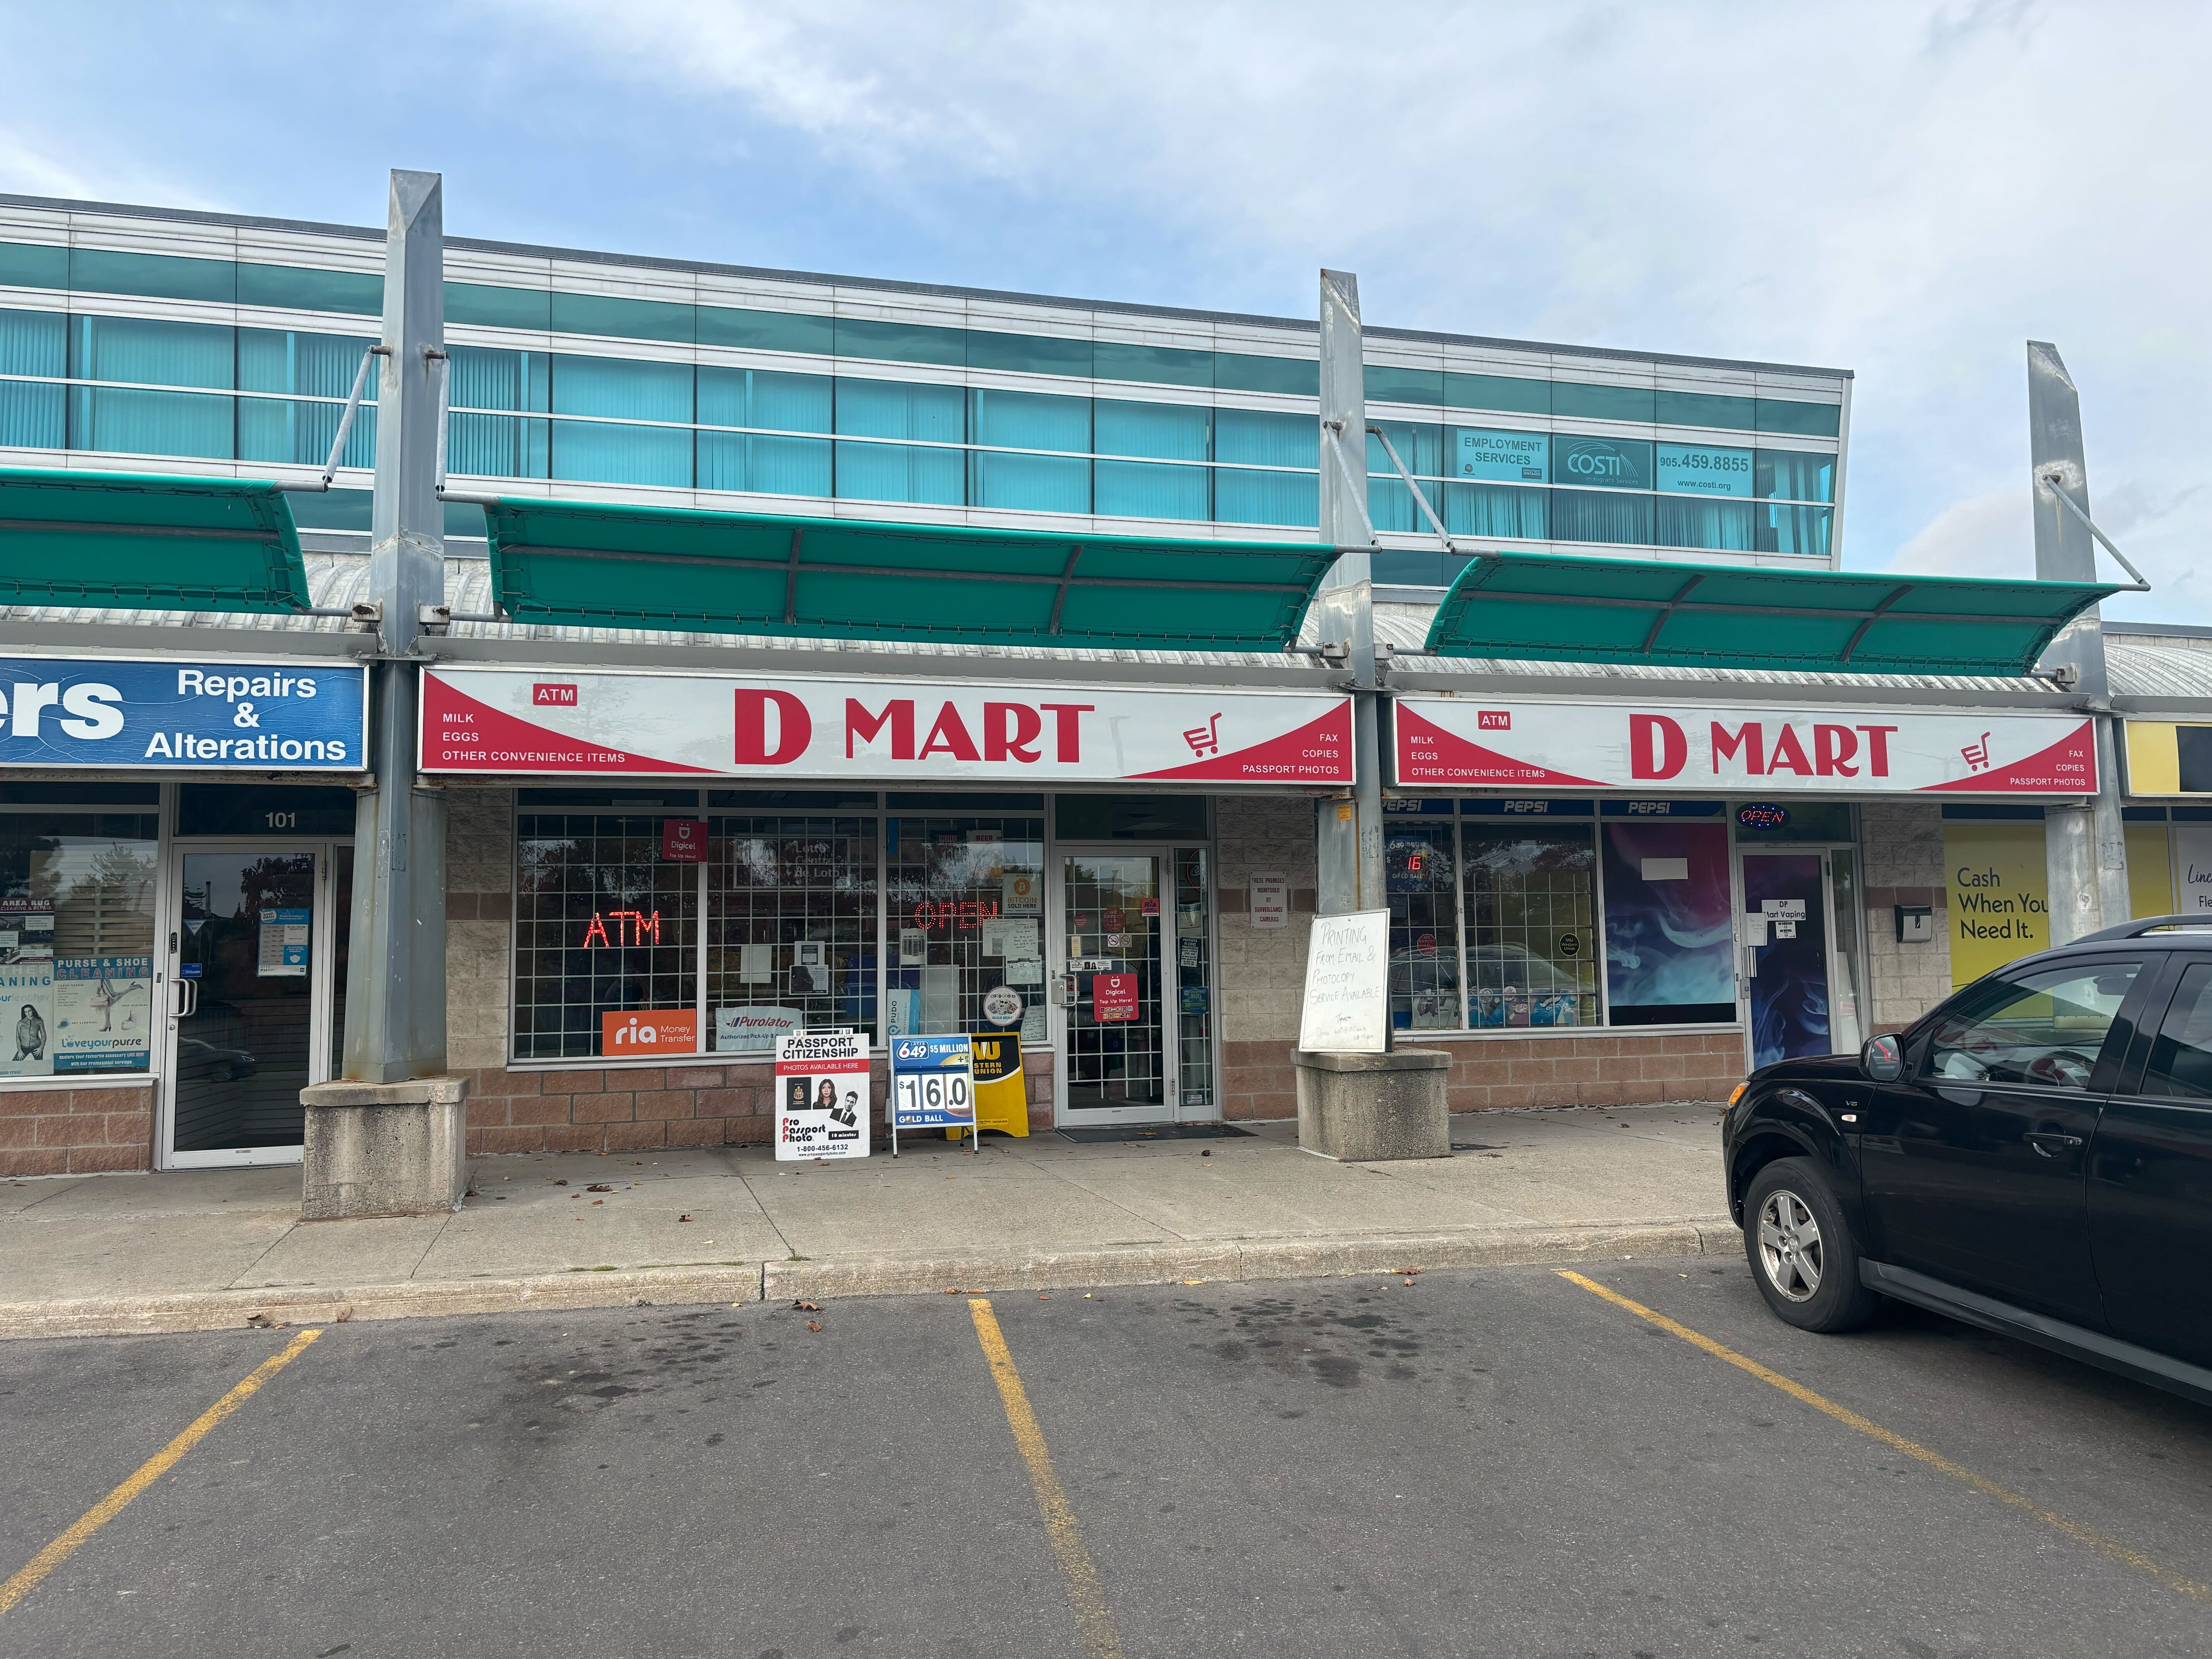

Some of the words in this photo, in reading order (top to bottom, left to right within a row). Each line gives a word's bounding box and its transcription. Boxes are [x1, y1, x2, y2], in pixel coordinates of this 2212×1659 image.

[1465, 437, 1542, 452] EMPLOYMENT
[1475, 452, 1530, 465] SERVICES
[1568, 453, 1620, 476] COSTI
[1660, 454, 1748, 472] 905.459.8855
[1678, 480, 1731, 490] www.costi.org
[179, 669, 316, 702] Repairs
[538, 689, 574, 701] ATM
[234, 702, 260, 728] &
[443, 713, 474, 723] MILK
[1482, 715, 1508, 726] ATM
[735, 688, 812, 764] D
[846, 698, 1095, 763] MART
[443, 732, 479, 742] EGGS
[1320, 734, 1338, 742] FAX
[144, 732, 346, 760] Alterations
[1629, 713, 1687, 780] D
[1710, 721, 1898, 777] MART
[442, 750, 487, 761] OTHER
[491, 752, 583, 762] CONVENIENCE
[587, 753, 625, 763] ITEMS
[1302, 750, 1338, 758] COPIES
[1411, 752, 1438, 760] EGGS
[1243, 765, 1296, 774] PASSPORT
[1299, 766, 1339, 774] PHOTOS
[1412, 768, 1444, 776] OTHER
[1447, 768, 1515, 777] CONVENIENCE
[1518, 769, 1545, 778] ITEMS
[1504, 801, 1548, 812] PEPSI
[1628, 802, 1670, 814] PEPSI
[265, 812, 296, 828] 101
[1741, 810, 1784, 823] OPEN
[672, 841, 696, 850] Digicel
[1389, 840, 1405, 849] 649
[1408, 857, 1421, 870] 16
[814, 868, 840, 877] Loto
[1957, 867, 2001, 888] Cash
[1958, 893, 2014, 913] When
[2018, 893, 2049, 913] You
[915, 902, 998, 929] OPEN
[1780, 911, 1805, 919] Vaping
[584, 911, 660, 948] ATM
[1321, 922, 1367, 946] PRINTING
[1960, 919, 2011, 939] Need
[2016, 919, 2034, 939] It.
[1316, 951, 1334, 965] FROM
[1338, 948, 1364, 963] EMAIL
[1367, 946, 1376, 961] &
[58, 959, 97, 967] PURSE
[103, 958, 110, 967] &
[117, 958, 148, 966] SHOE
[57, 967, 149, 979] CLEANING
[1312, 969, 1355, 986] PHOTOCOPY
[1310, 989, 1338, 1005] SERVICE
[1342, 986, 1380, 1001] AVAILABLE
[739, 1016, 793, 1028] Purolator
[616, 1017, 656, 1044] ria
[660, 1025, 690, 1034] Money
[62, 1039, 142, 1049] Loveyourpurse
[660, 1035, 696, 1043] Transfer
[788, 1037, 854, 1048] PASSPORT
[783, 1048, 858, 1059] CITIZENSHIP
[899, 1042, 927, 1058] 649
[930, 1044, 938, 1053] $5
[939, 1044, 968, 1053] MILLION
[783, 1117, 799, 1126] Pro
[783, 1124, 826, 1135] Passport
[783, 1133, 813, 1142] Photo
[797, 1144, 848, 1152] 1-800-456-6132
